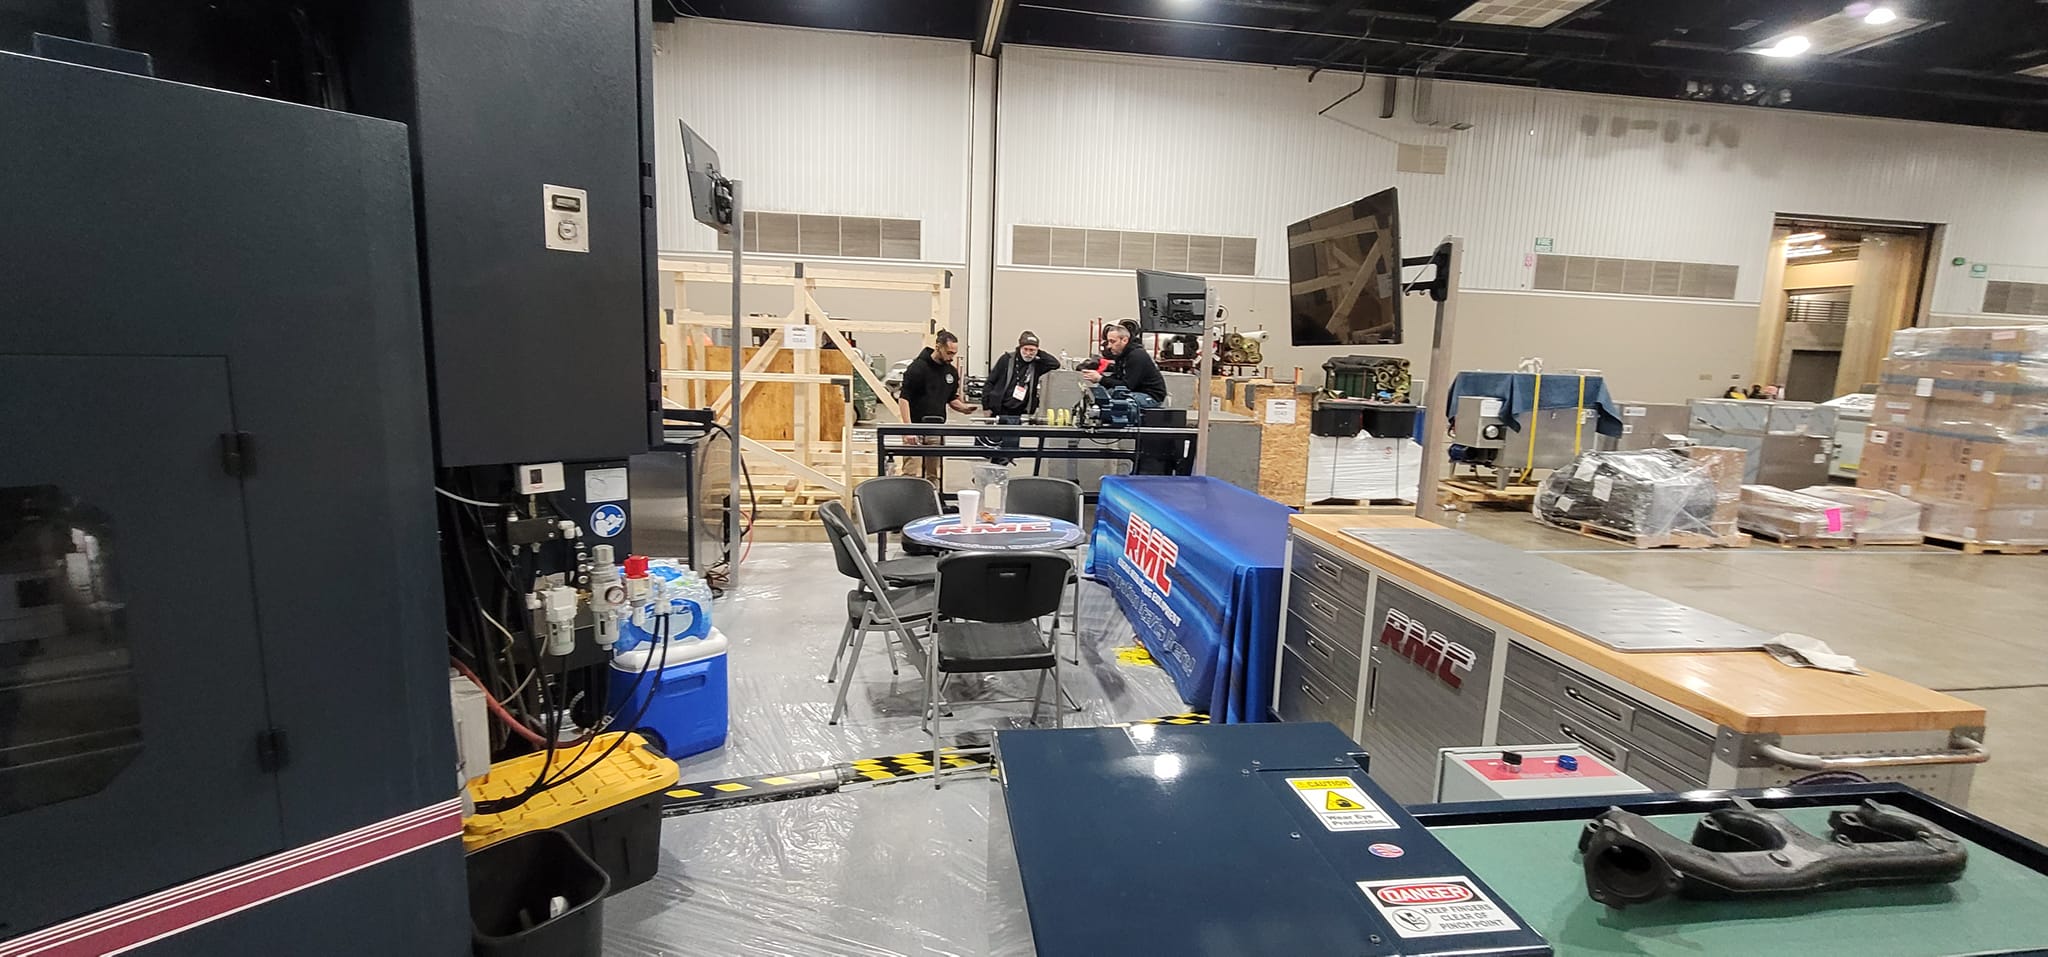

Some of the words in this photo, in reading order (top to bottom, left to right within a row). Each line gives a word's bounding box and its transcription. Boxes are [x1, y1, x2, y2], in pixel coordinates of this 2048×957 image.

[932, 521, 1051, 535] RMC
[1124, 512, 1179, 597] RMC
[1379, 608, 1477, 689] RMC
[1385, 886, 1464, 902] DANGER
[1422, 906, 1448, 914] KEEP
[1450, 904, 1493, 913] FINGERS
[1441, 913, 1471, 921] CLEAR
[1440, 921, 1471, 930] PINCH
[1474, 919, 1504, 928] POINT
